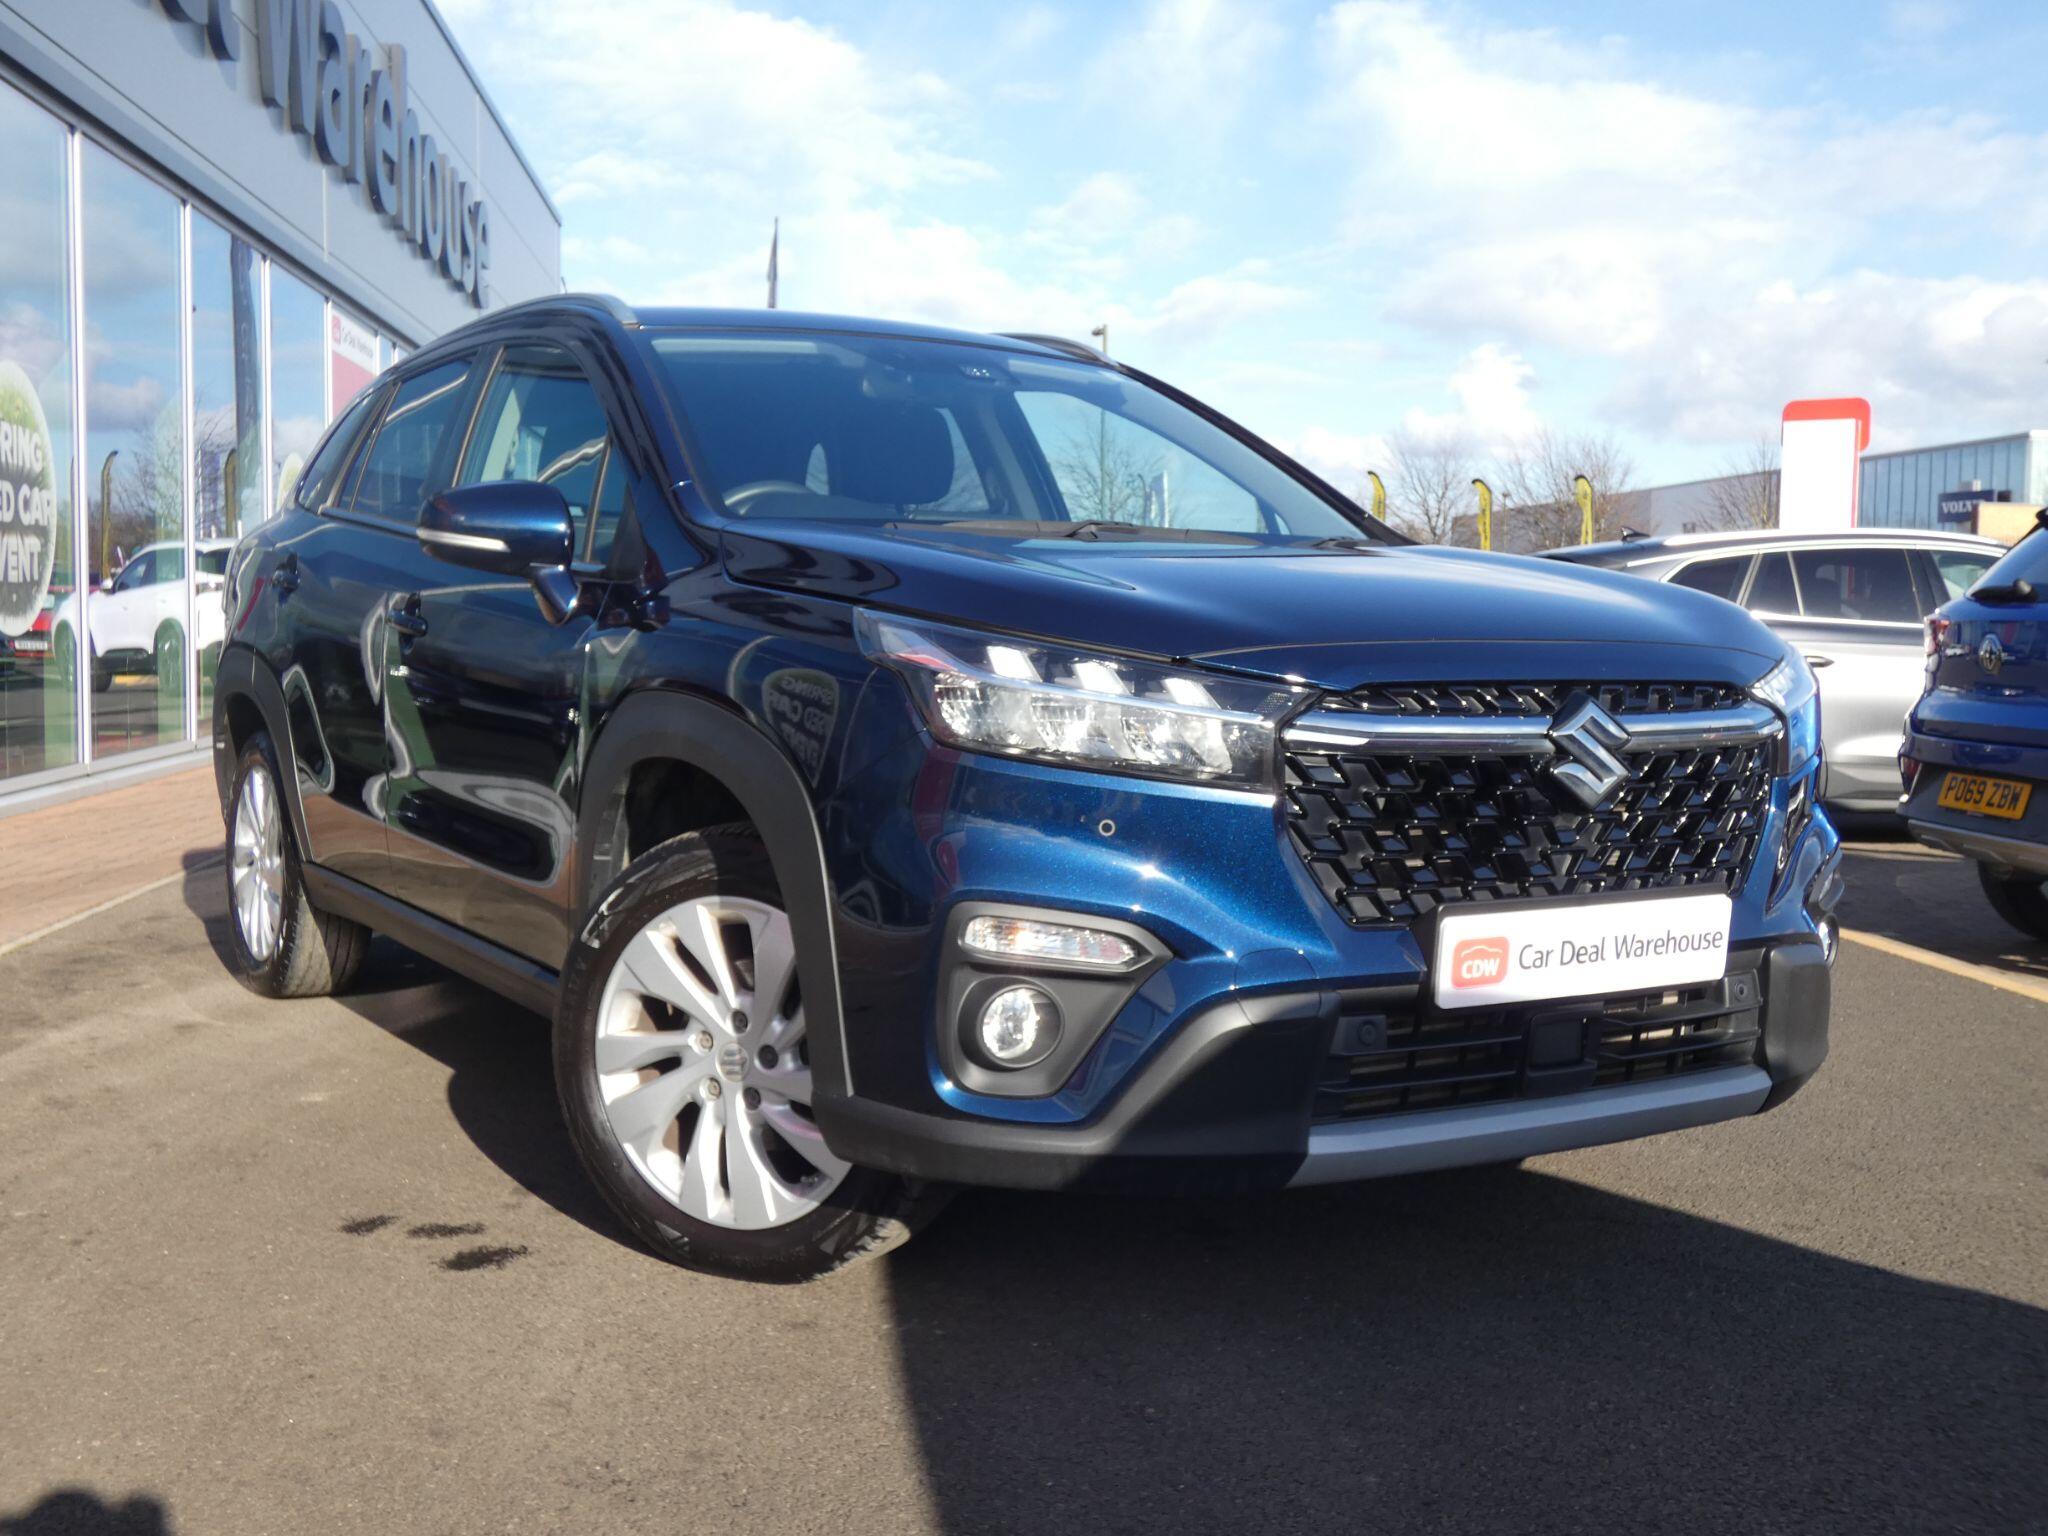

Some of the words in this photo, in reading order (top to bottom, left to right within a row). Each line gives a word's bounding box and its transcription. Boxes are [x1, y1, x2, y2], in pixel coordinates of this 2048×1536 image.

[0, 479, 15, 523] D
[1461, 958, 1501, 979] CDW
[1518, 943, 1554, 970] Car
[1560, 937, 1606, 966] Deal
[1614, 930, 1723, 959] Warehouse
